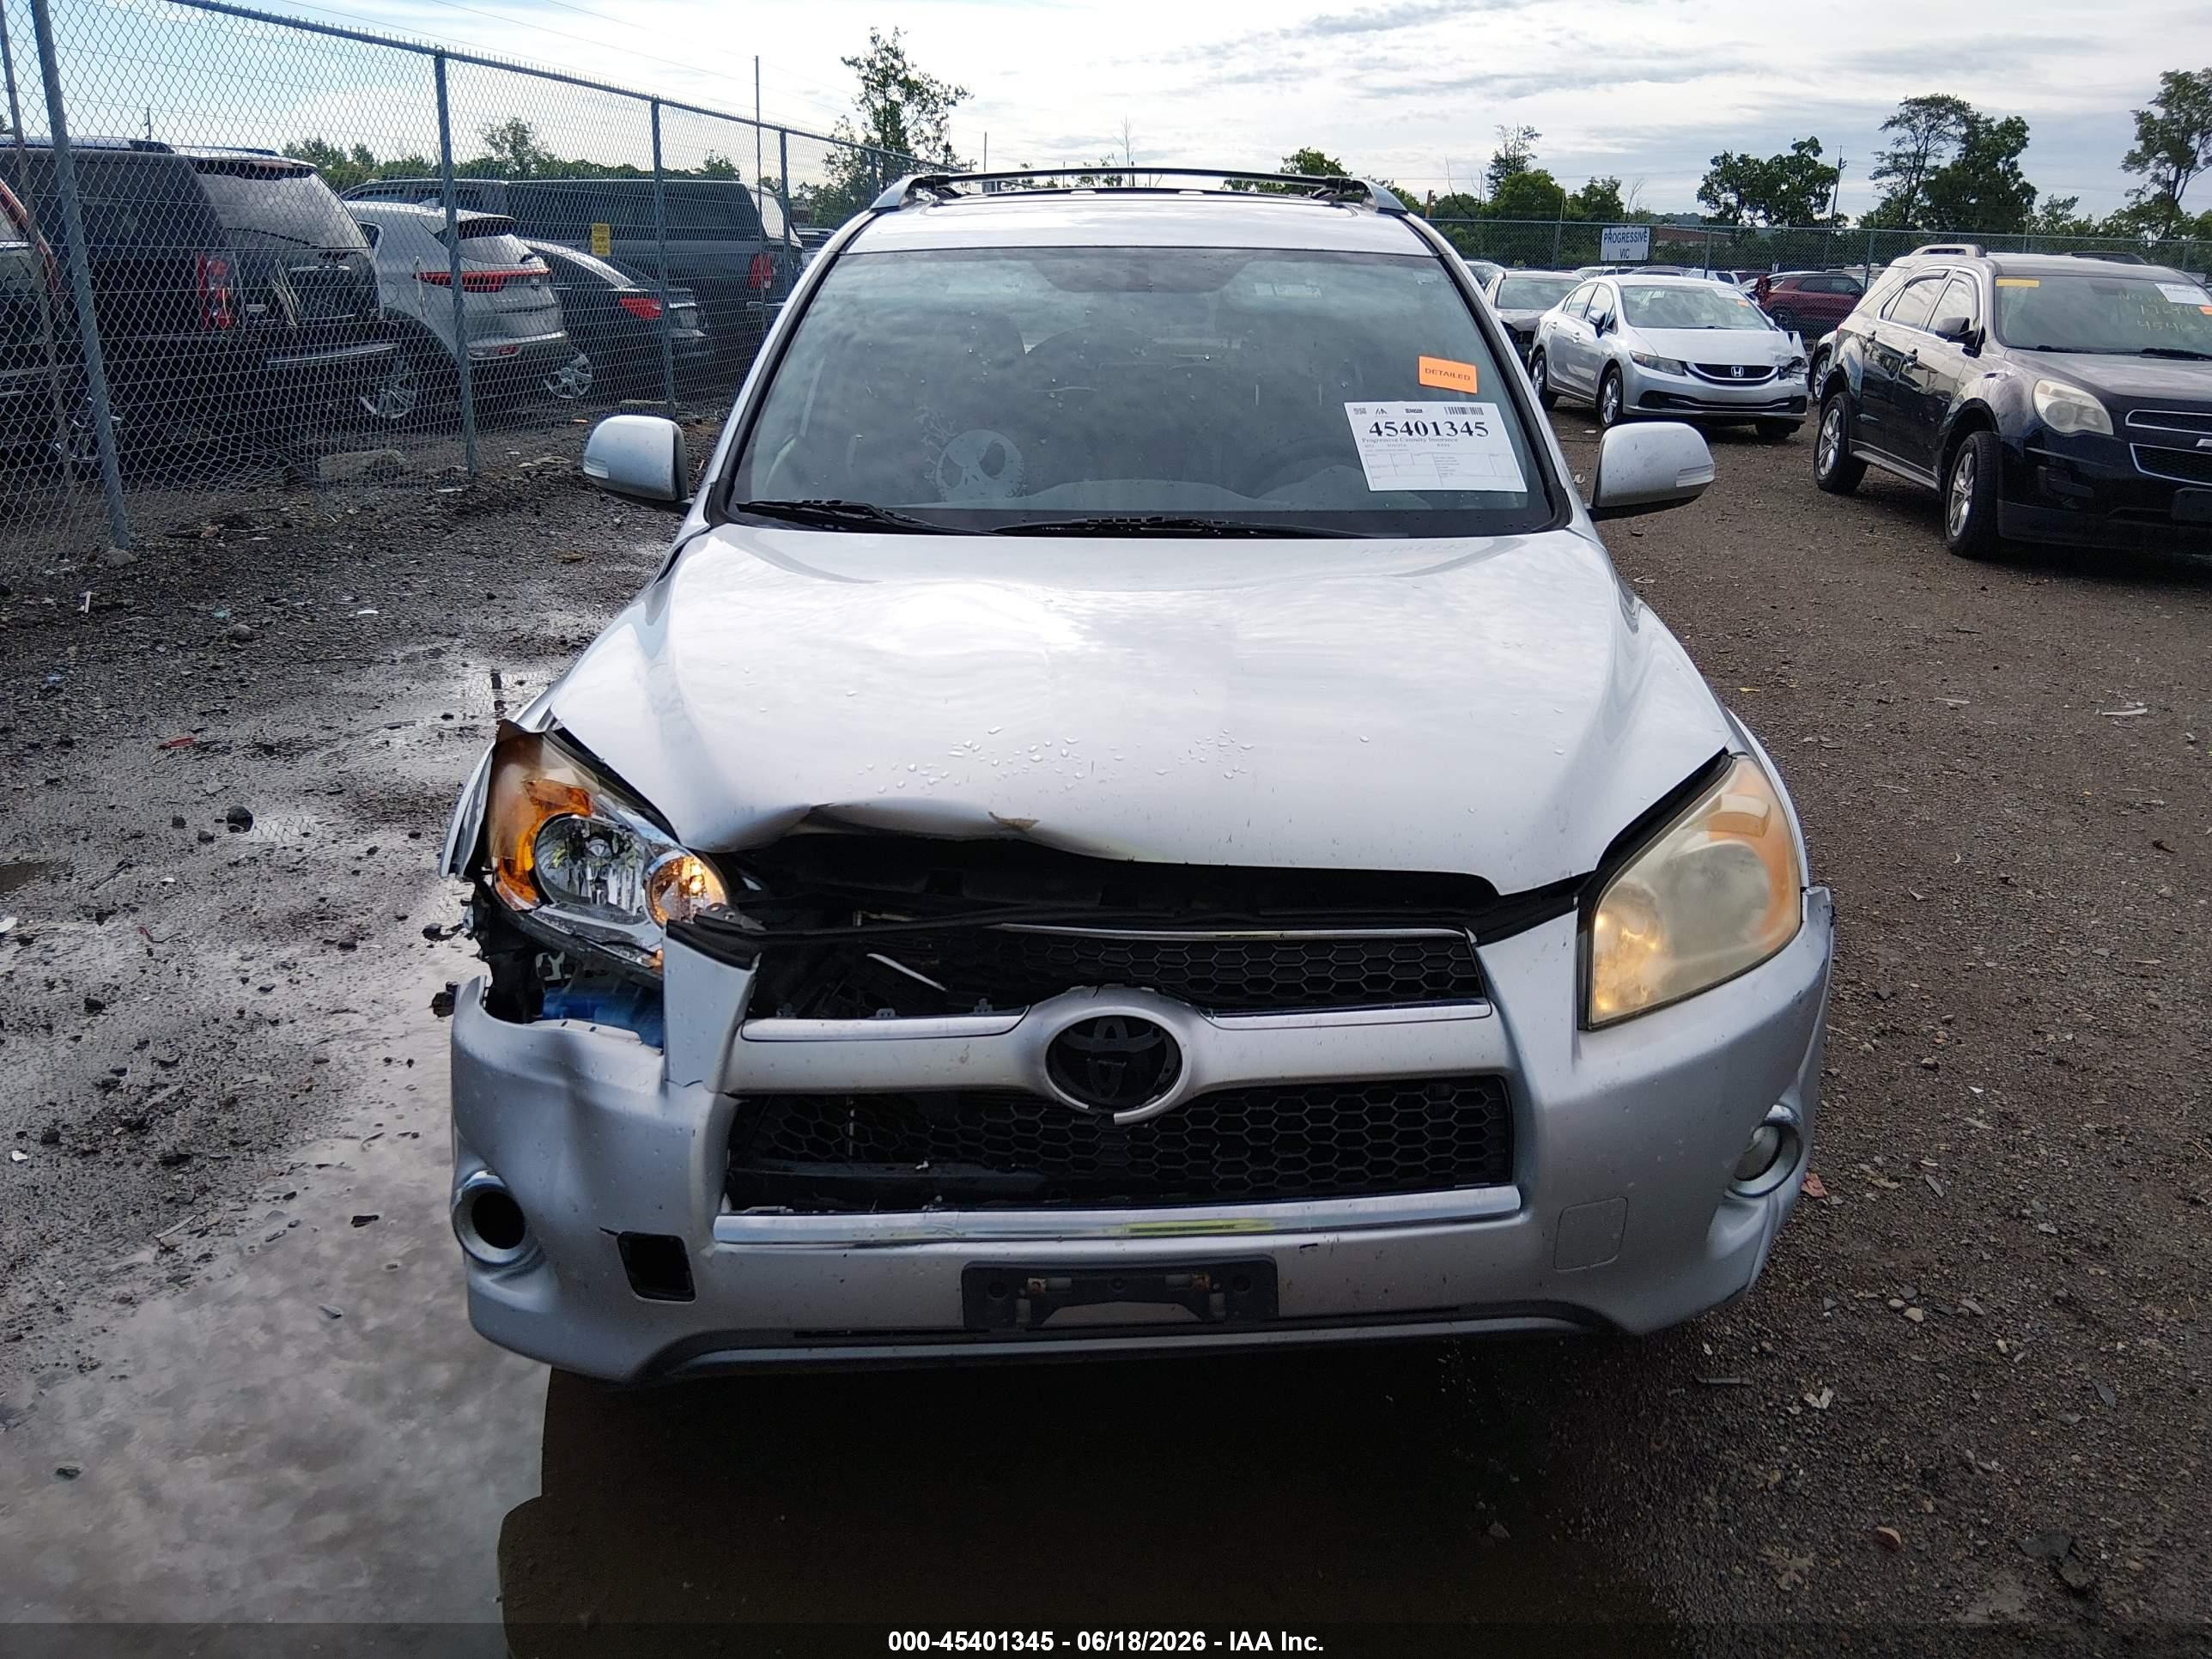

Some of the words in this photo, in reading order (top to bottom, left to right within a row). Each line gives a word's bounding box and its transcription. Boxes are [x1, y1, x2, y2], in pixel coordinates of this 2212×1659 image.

[1603, 232, 1648, 244] PROGRESSIVE
[1620, 248, 1630, 259] VIC
[1425, 368, 1471, 381] DETAILED
[1369, 420, 1489, 437] 45401345
